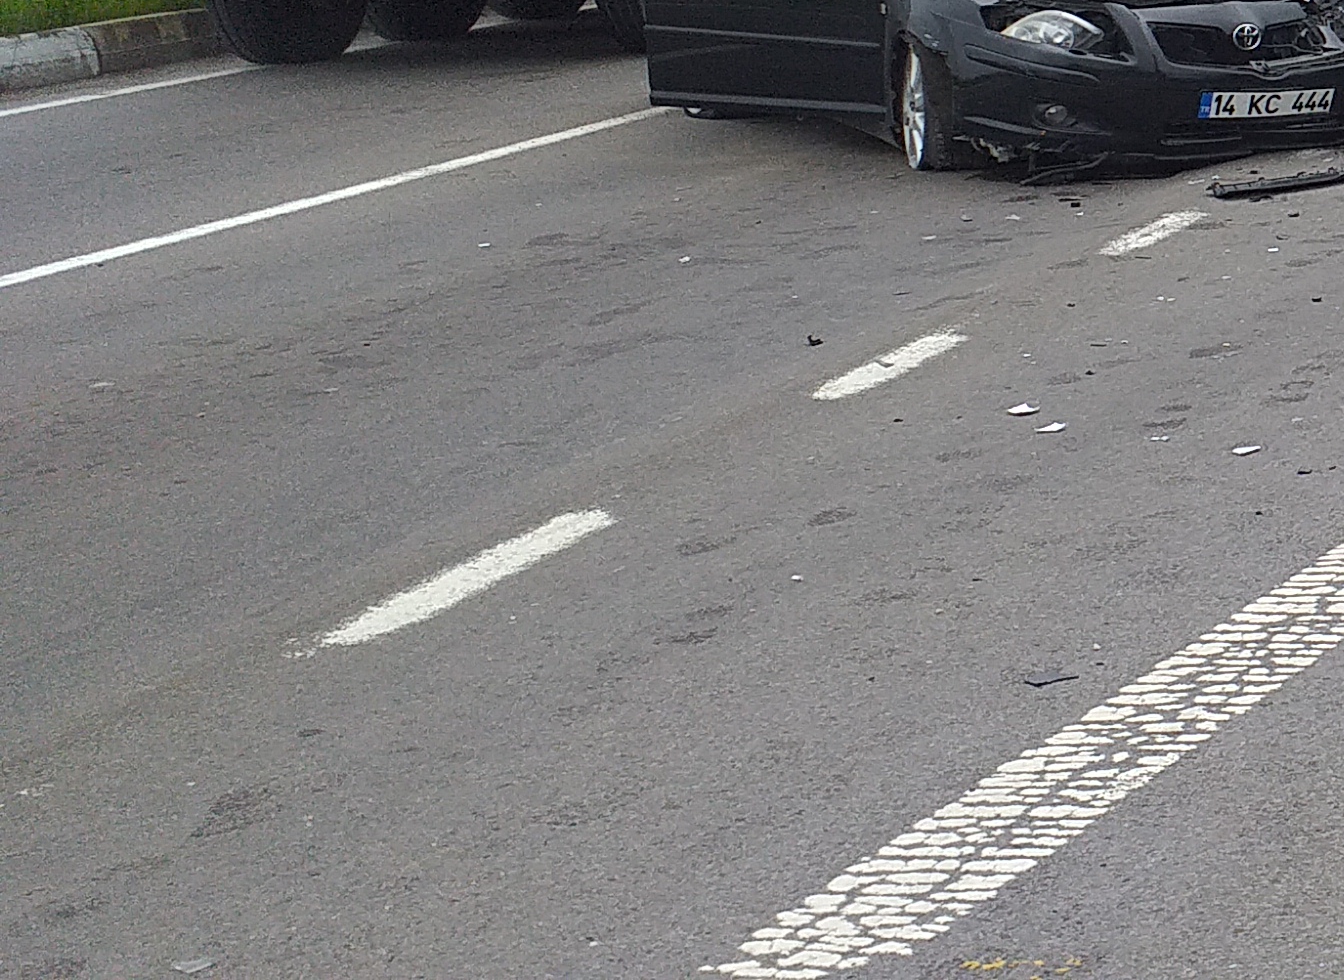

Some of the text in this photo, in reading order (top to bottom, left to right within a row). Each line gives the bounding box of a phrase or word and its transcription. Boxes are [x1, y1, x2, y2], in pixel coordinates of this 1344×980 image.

[1214, 94, 1236, 116] 14
[1247, 94, 1282, 115] KC
[1291, 90, 1330, 112] 444
